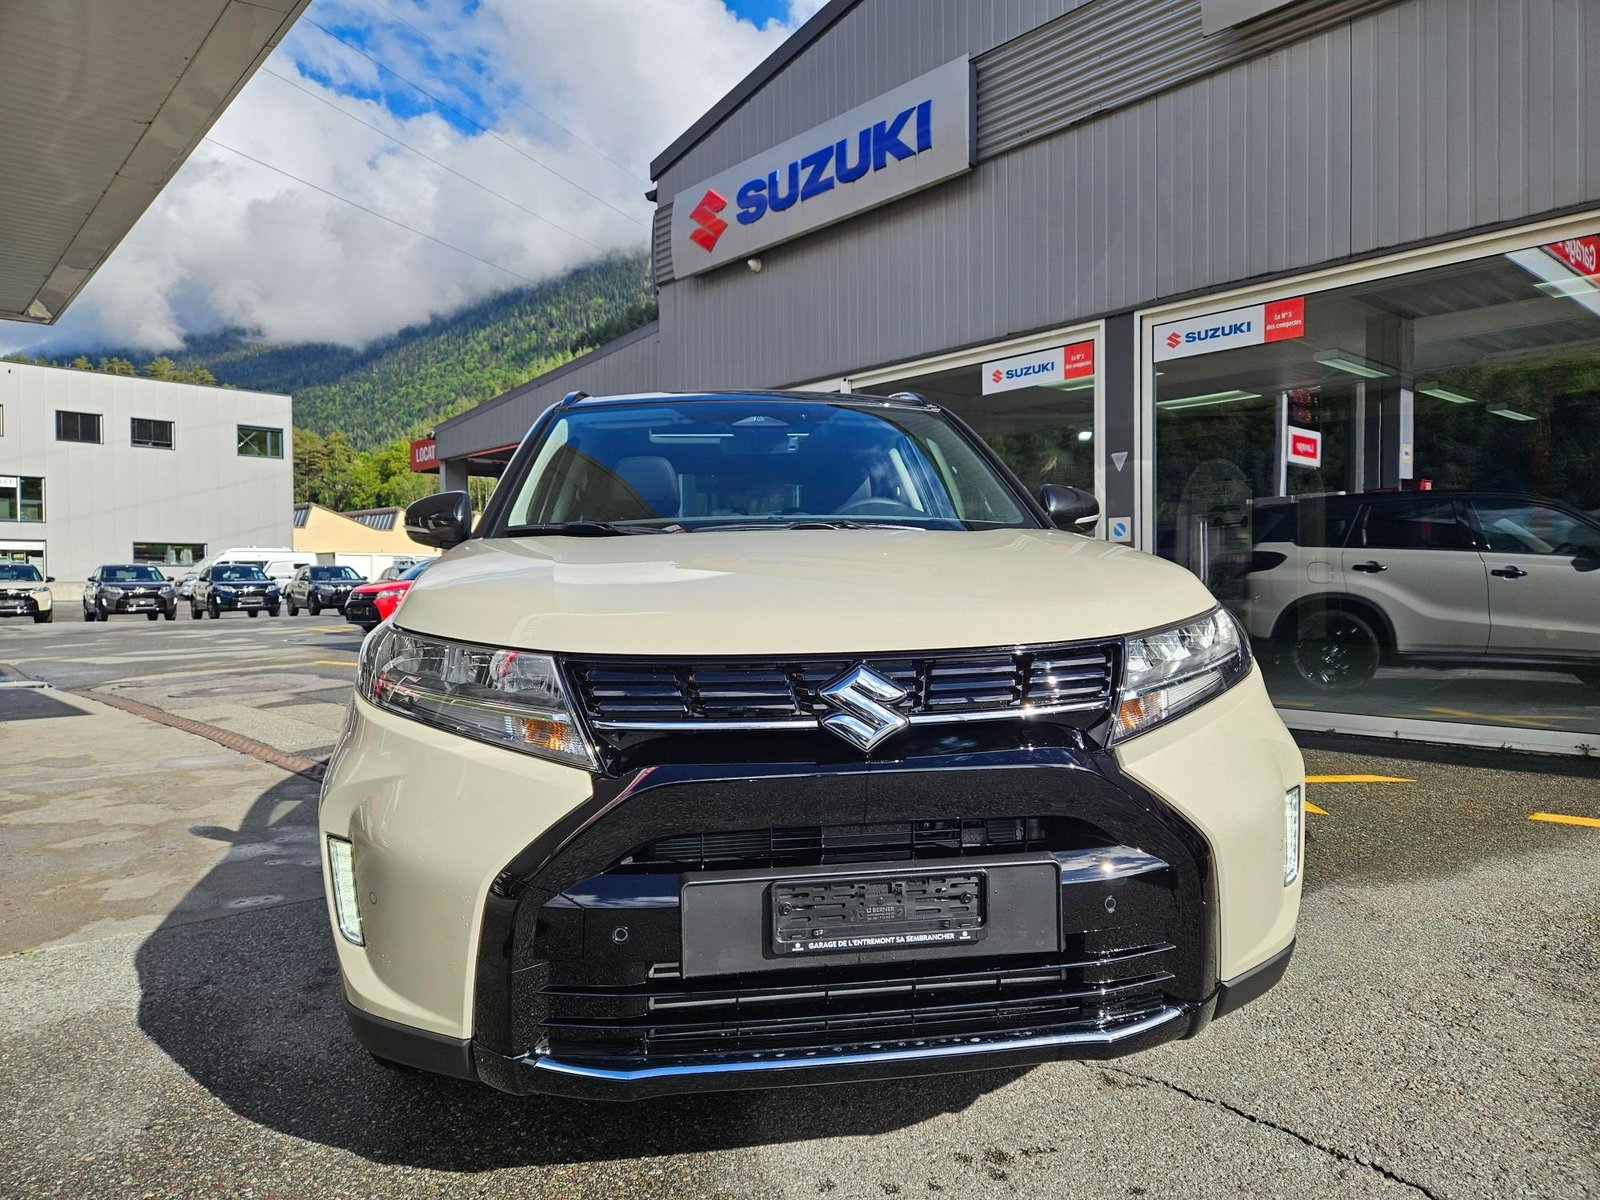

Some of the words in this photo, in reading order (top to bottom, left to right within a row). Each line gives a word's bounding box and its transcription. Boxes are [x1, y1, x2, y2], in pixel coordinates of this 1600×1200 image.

[736, 99, 932, 225] SUZUKI
[1185, 321, 1251, 343] SUZUKI
[1276, 320, 1302, 328] compactes
[1005, 361, 1055, 379] SUZUKI
[808, 941, 837, 949] GARAGE
[848, 936, 895, 946] L'ENTREMONT
[896, 935, 905, 943] SA
[906, 932, 955, 942] SEMBRANCHER
